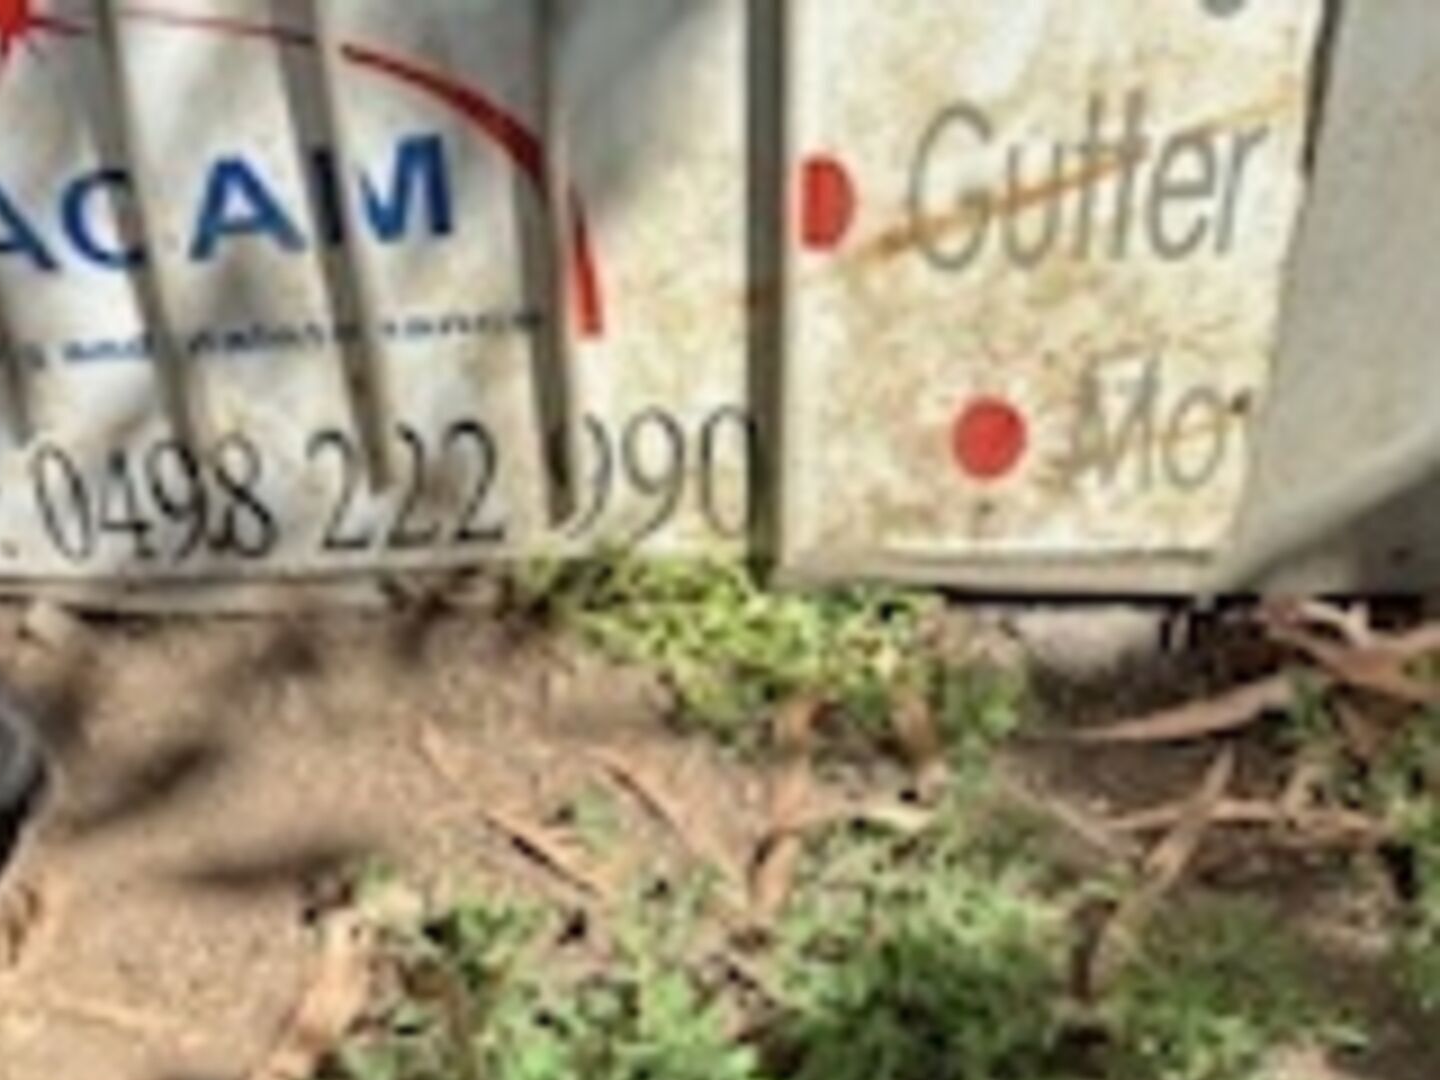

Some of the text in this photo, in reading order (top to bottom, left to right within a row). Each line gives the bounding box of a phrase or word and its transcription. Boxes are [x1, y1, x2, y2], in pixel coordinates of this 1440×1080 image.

[908, 90, 1268, 273] Gutter
[31, 433, 279, 562] 0498
[304, 418, 505, 550] 222
